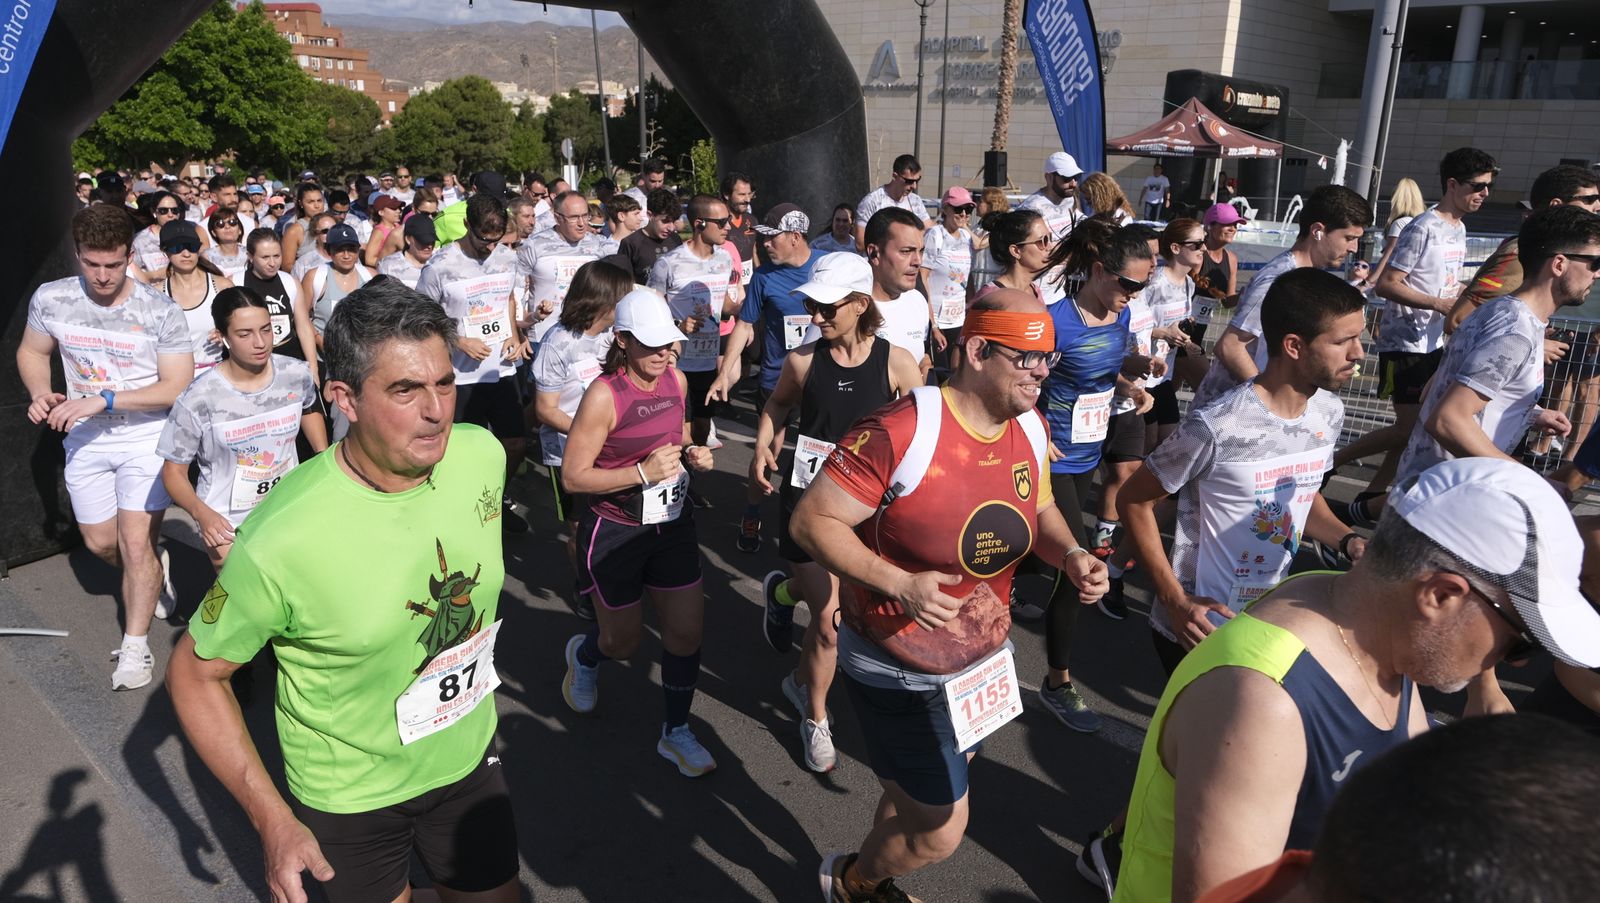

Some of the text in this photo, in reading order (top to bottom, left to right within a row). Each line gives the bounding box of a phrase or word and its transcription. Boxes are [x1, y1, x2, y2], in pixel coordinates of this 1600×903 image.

[0, 0, 31, 74] centro
[481, 321, 501, 335] 86
[650, 400, 674, 413] LURBEL
[976, 531, 994, 540] uno
[975, 544, 1010, 556] cienmil
[976, 539, 1002, 549] entre
[971, 555, 990, 564] .org
[439, 659, 478, 703] 87
[961, 674, 1011, 721] 1155
